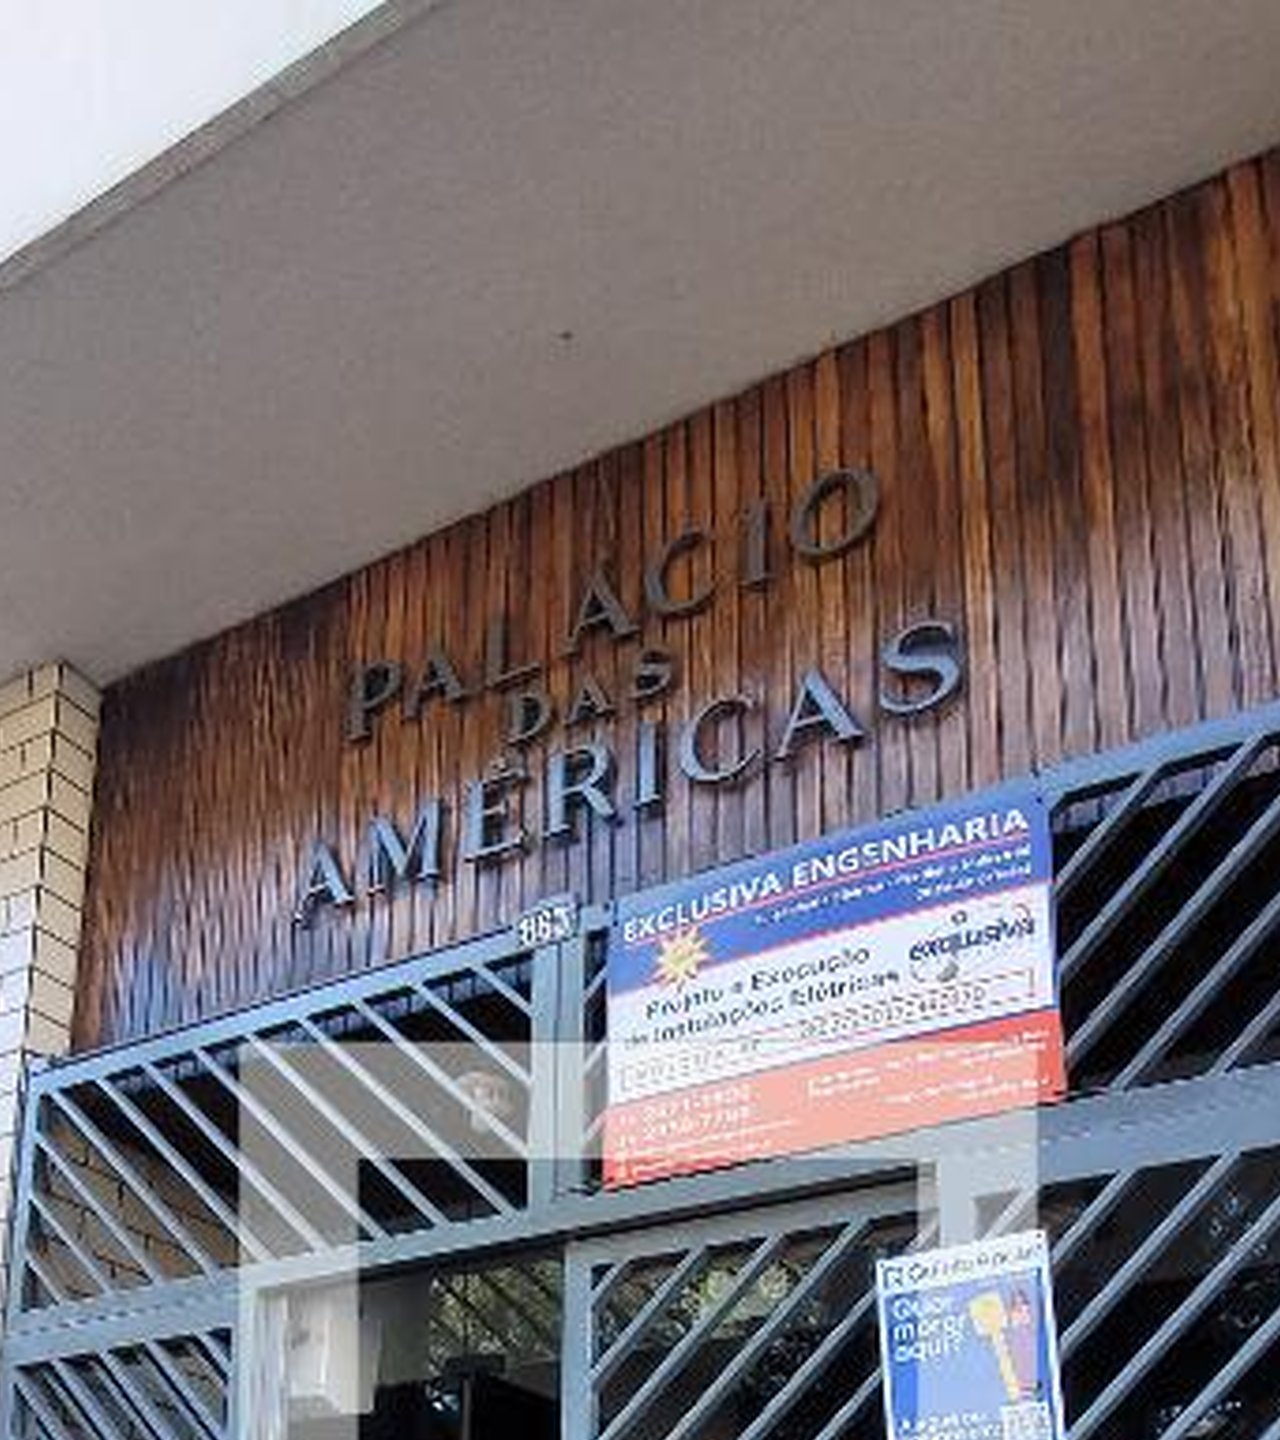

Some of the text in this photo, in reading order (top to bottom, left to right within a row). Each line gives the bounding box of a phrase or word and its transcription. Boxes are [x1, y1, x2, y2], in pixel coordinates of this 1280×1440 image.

[507, 648, 673, 745] DAS
[293, 620, 966, 922] AMÉRICAS
[623, 872, 783, 943] EXCLUSIVA
[792, 808, 1029, 890] ENGENHARIA
